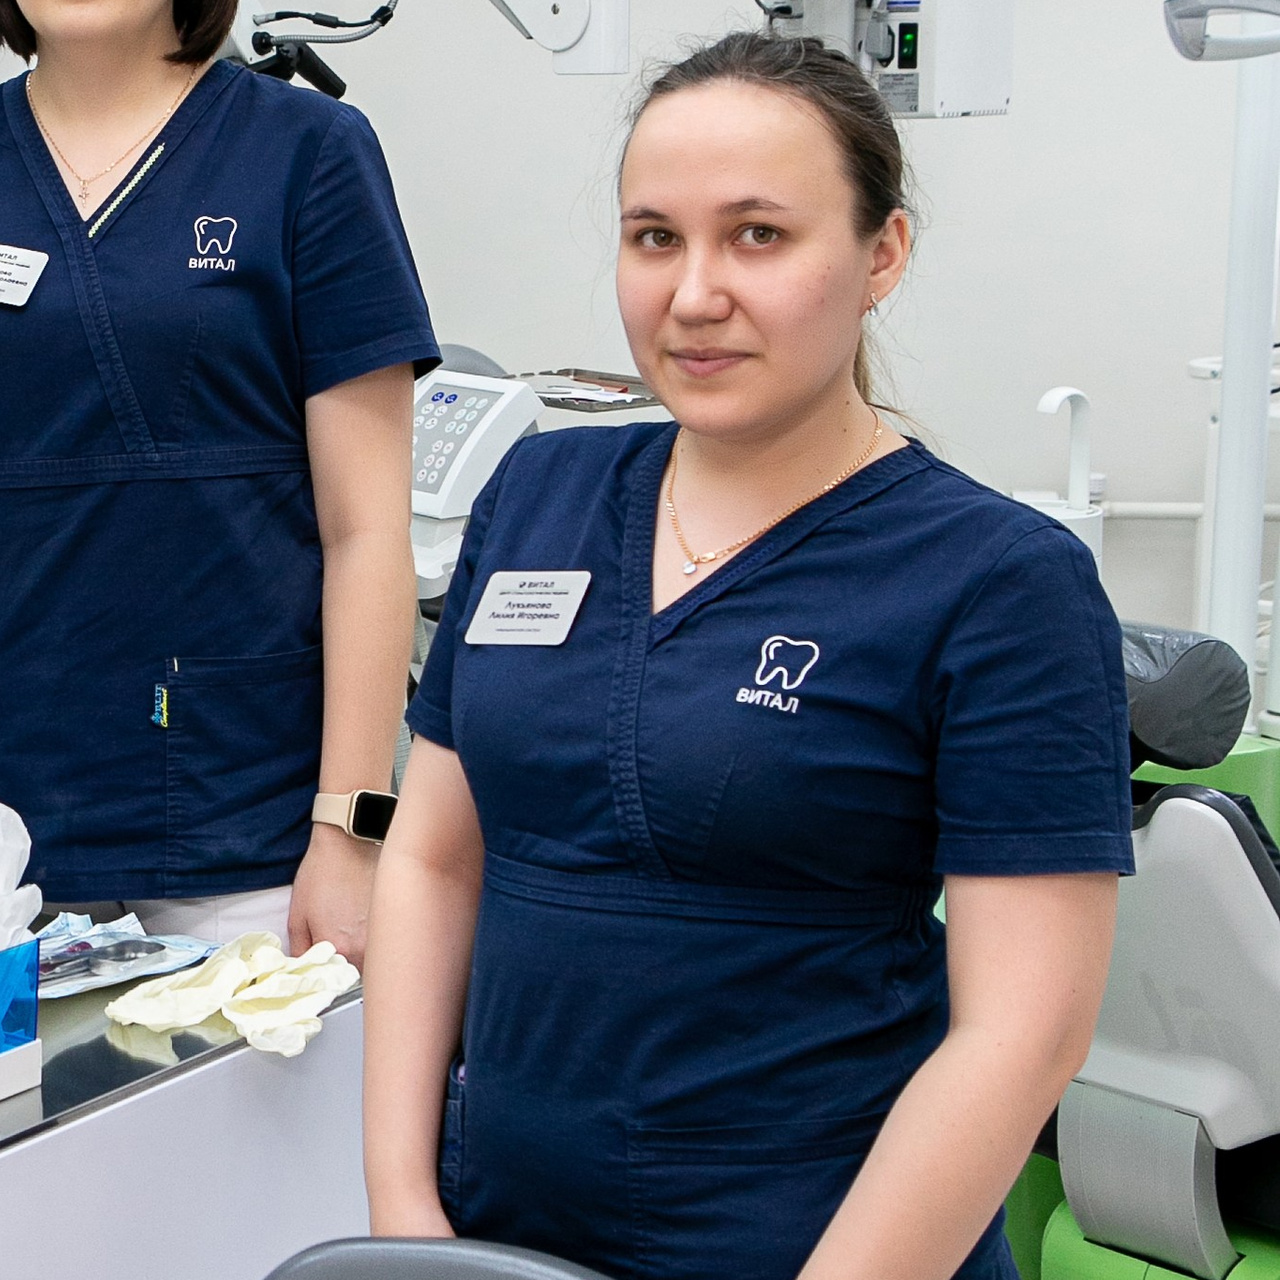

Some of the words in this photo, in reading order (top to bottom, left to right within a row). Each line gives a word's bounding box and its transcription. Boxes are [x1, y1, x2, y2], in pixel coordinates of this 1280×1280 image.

[188, 257, 236, 272] ВИТАЛ
[527, 581, 555, 589] ВИТАЛ
[735, 687, 800, 714] ВИТАЛ
